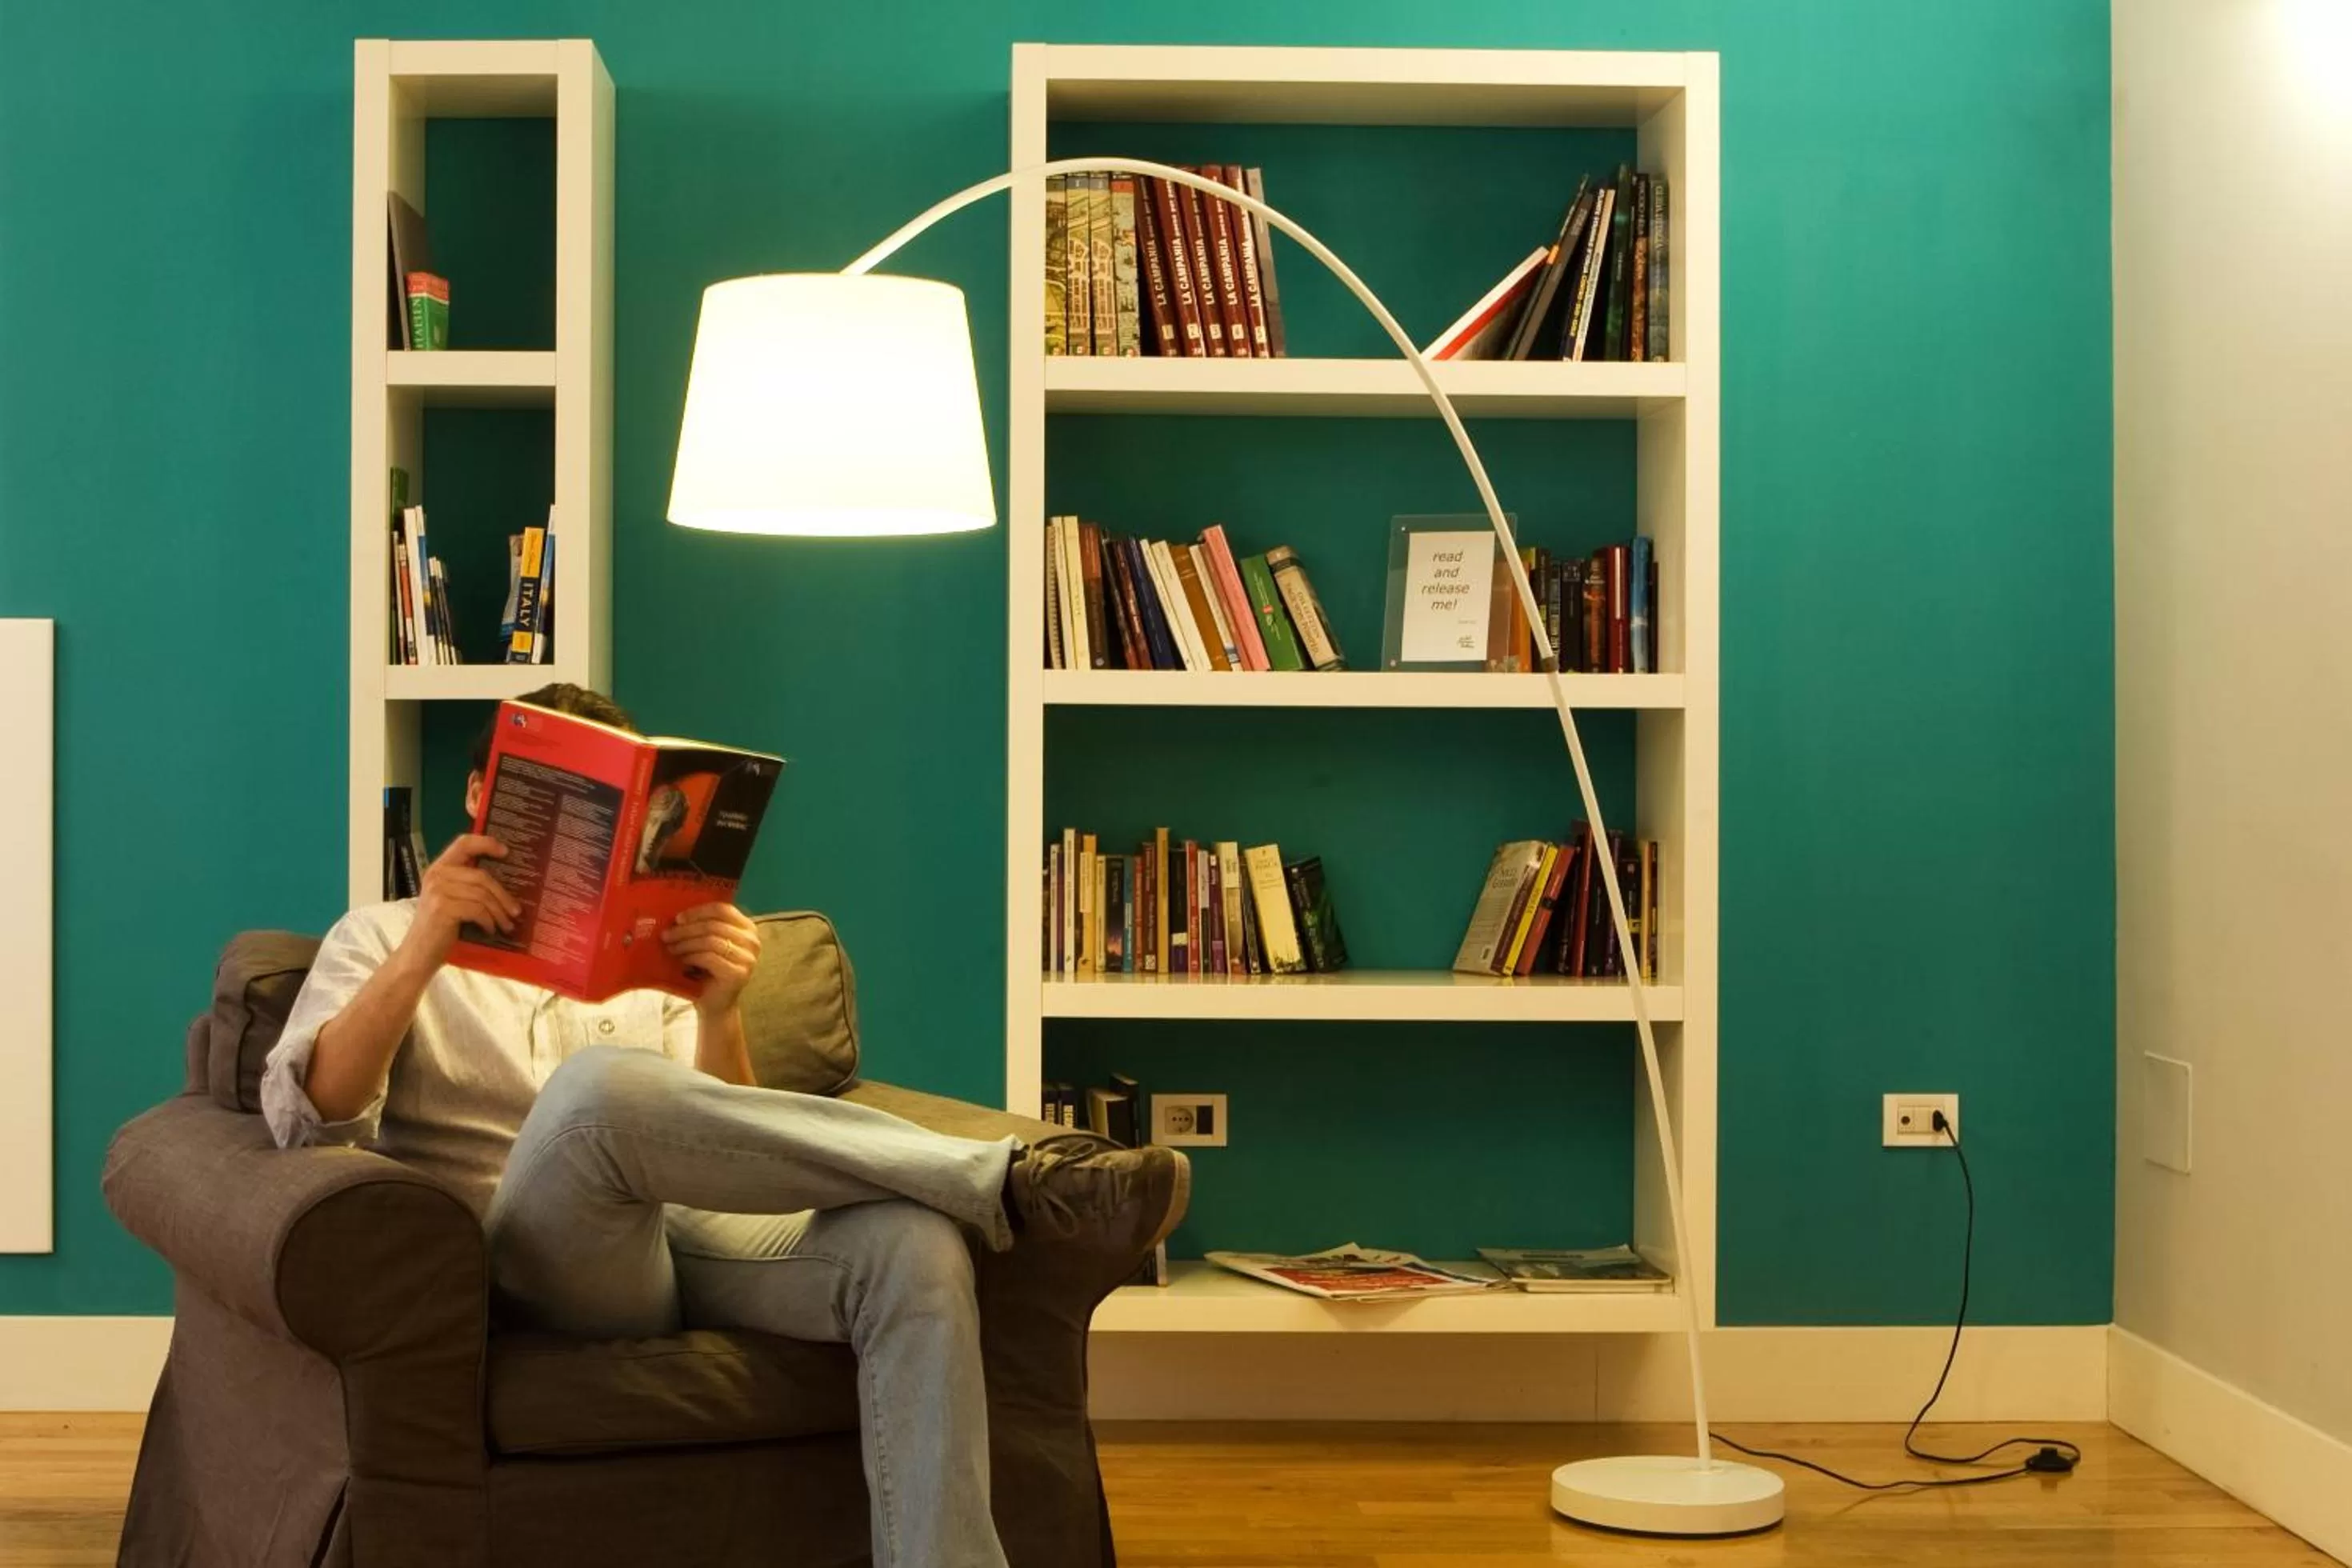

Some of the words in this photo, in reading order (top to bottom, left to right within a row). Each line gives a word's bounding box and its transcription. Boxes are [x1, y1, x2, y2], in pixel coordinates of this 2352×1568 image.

[1147, 239, 1165, 291] CAMPANIA
[1172, 238, 1190, 290] CAMPANIA
[1195, 238, 1213, 290] CAMPANIA
[1218, 238, 1234, 290] CAMPANIA
[1242, 241, 1258, 292] CAMPANIA
[1157, 292, 1167, 306] LA
[1182, 291, 1193, 306] LA
[1204, 291, 1215, 306] LA
[1226, 292, 1238, 306] LA
[1250, 293, 1261, 306] LA
[1432, 550, 1464, 562] read
[1434, 567, 1460, 578] and
[1422, 582, 1470, 594] release
[520, 582, 534, 627] ITALY
[1431, 598, 1458, 610] me!
